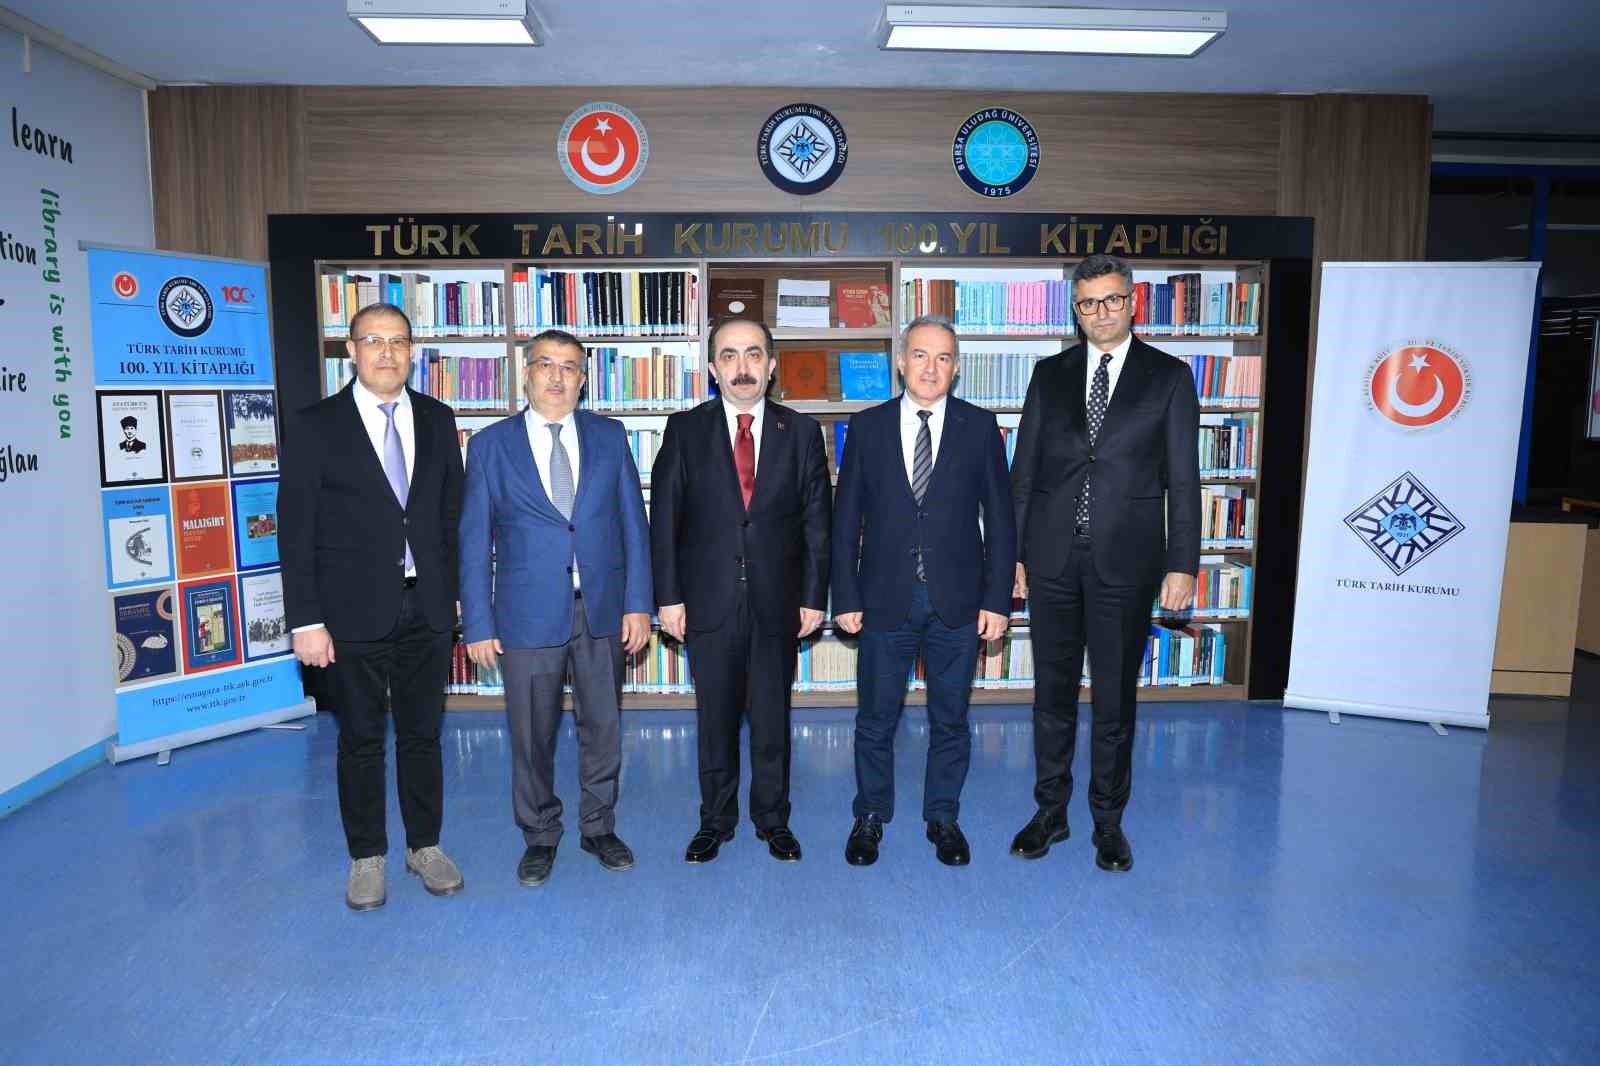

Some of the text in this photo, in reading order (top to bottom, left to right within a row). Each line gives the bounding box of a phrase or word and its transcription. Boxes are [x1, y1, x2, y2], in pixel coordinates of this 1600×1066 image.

[775, 106, 807, 122] KURUMU
[12, 106, 73, 164] learn
[954, 137, 965, 170] BURSA
[984, 187, 1011, 196] 1975
[365, 215, 1228, 256] TÜRK TARİH KURUMU 100. YIL KİTAPLIĞI
[40, 187, 72, 439] library is with you
[127, 343, 247, 358] TÜRK TARİH KURUMU
[119, 359, 256, 376] 100. YIL KİTAPLIĞI
[1336, 578, 1461, 597] TÜRK TARİH KURUMU
